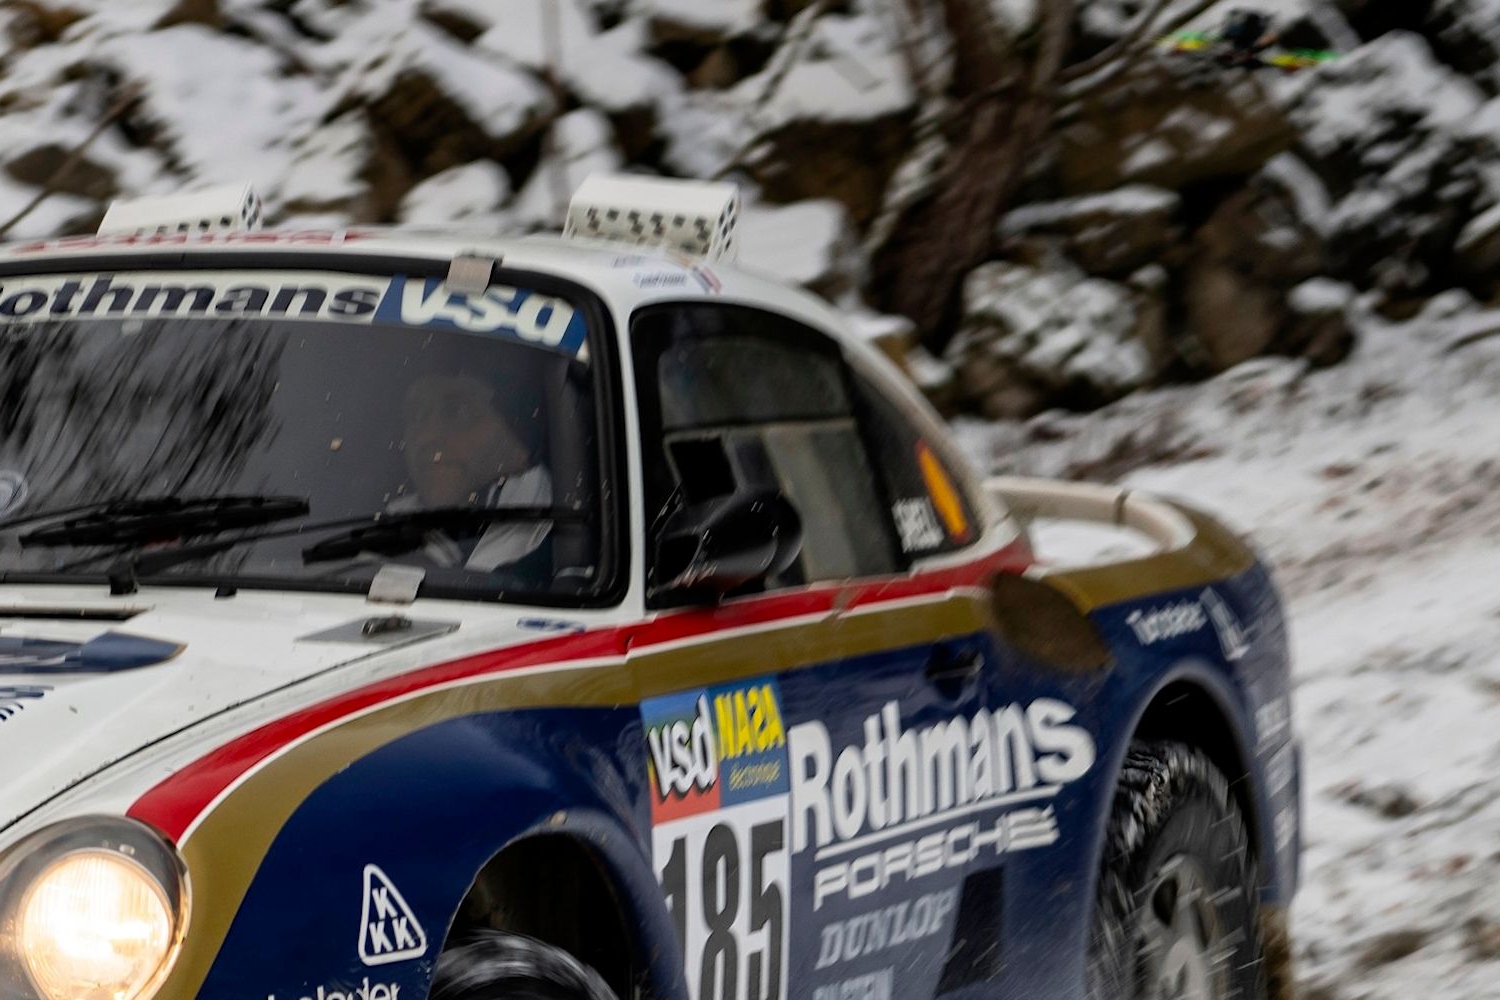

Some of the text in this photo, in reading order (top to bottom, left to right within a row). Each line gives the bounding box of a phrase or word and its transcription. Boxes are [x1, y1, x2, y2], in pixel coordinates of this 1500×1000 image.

[787, 697, 1095, 854] Rothmans
[814, 804, 1060, 911] PORSCHE
[814, 886, 958, 971] DUNLOP
